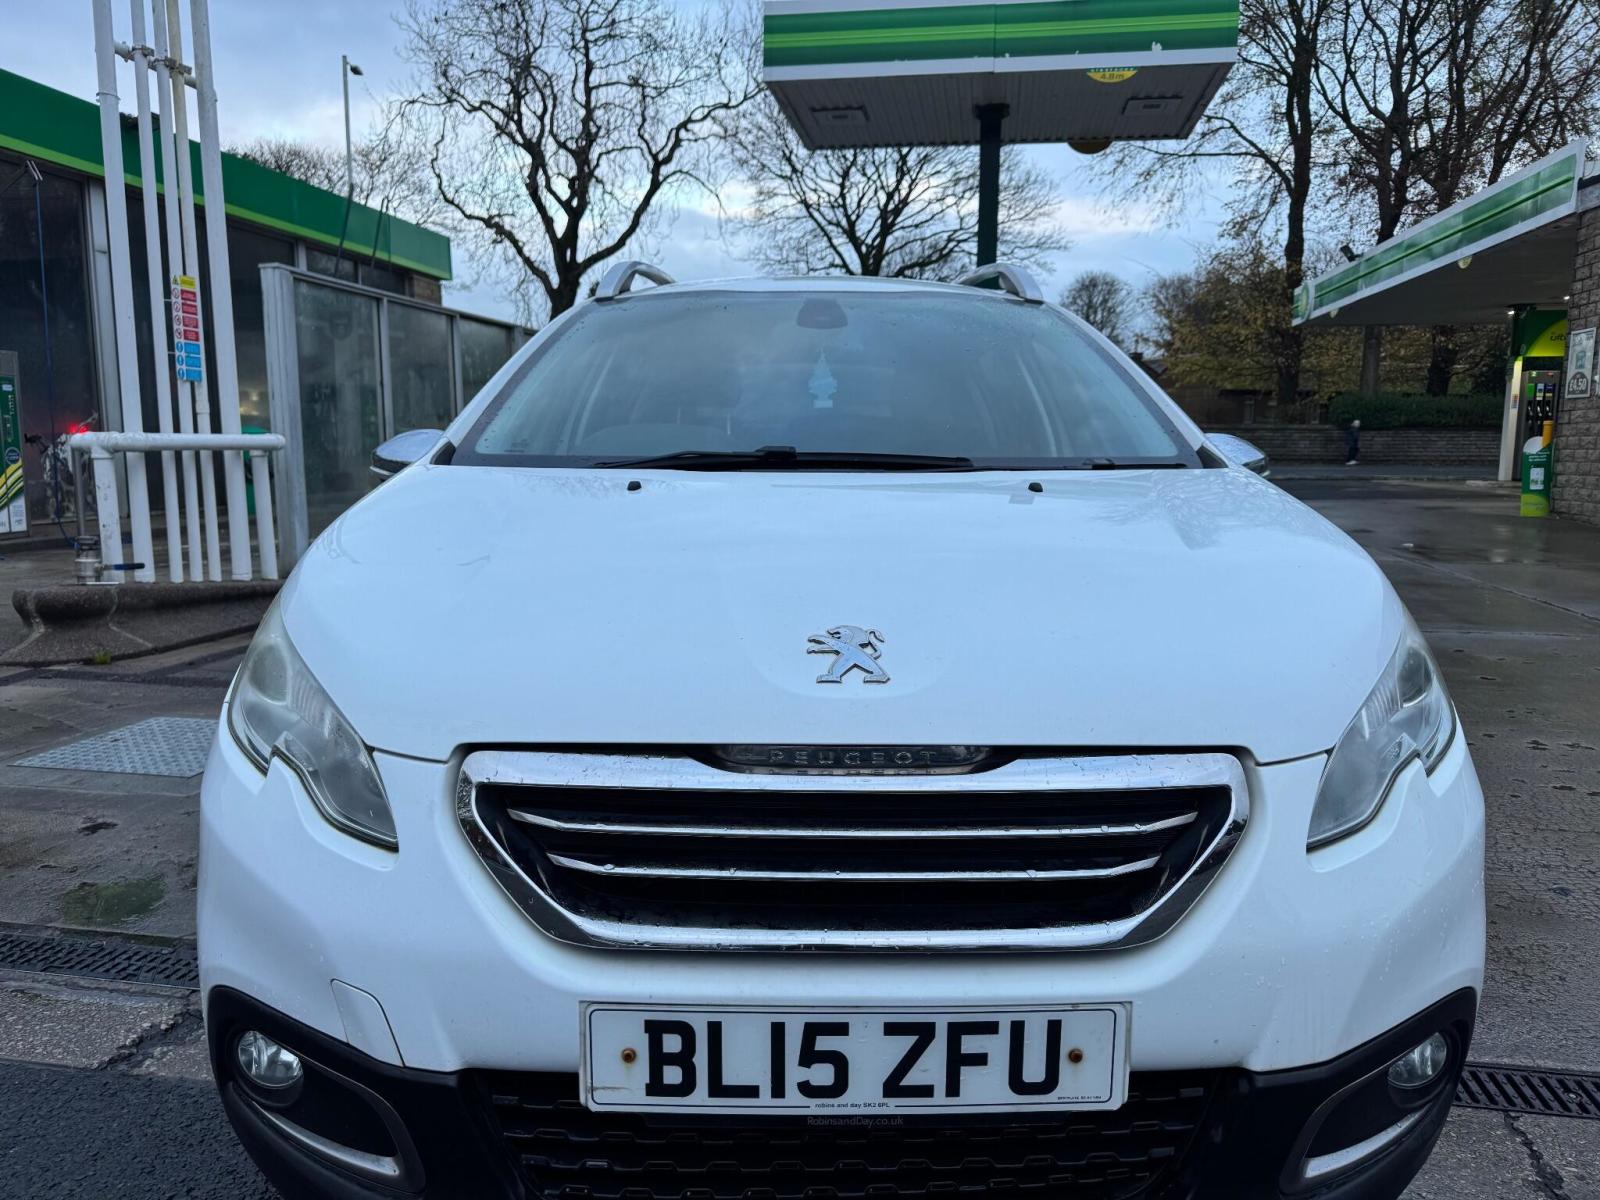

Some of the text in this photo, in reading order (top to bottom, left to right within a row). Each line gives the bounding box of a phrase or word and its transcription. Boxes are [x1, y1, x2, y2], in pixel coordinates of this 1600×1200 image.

[768, 750, 937, 765] PEUGEOT
[643, 1018, 1062, 1099] BL15 ZFU
[807, 1116, 904, 1128] RobinsandDay.co.uk
